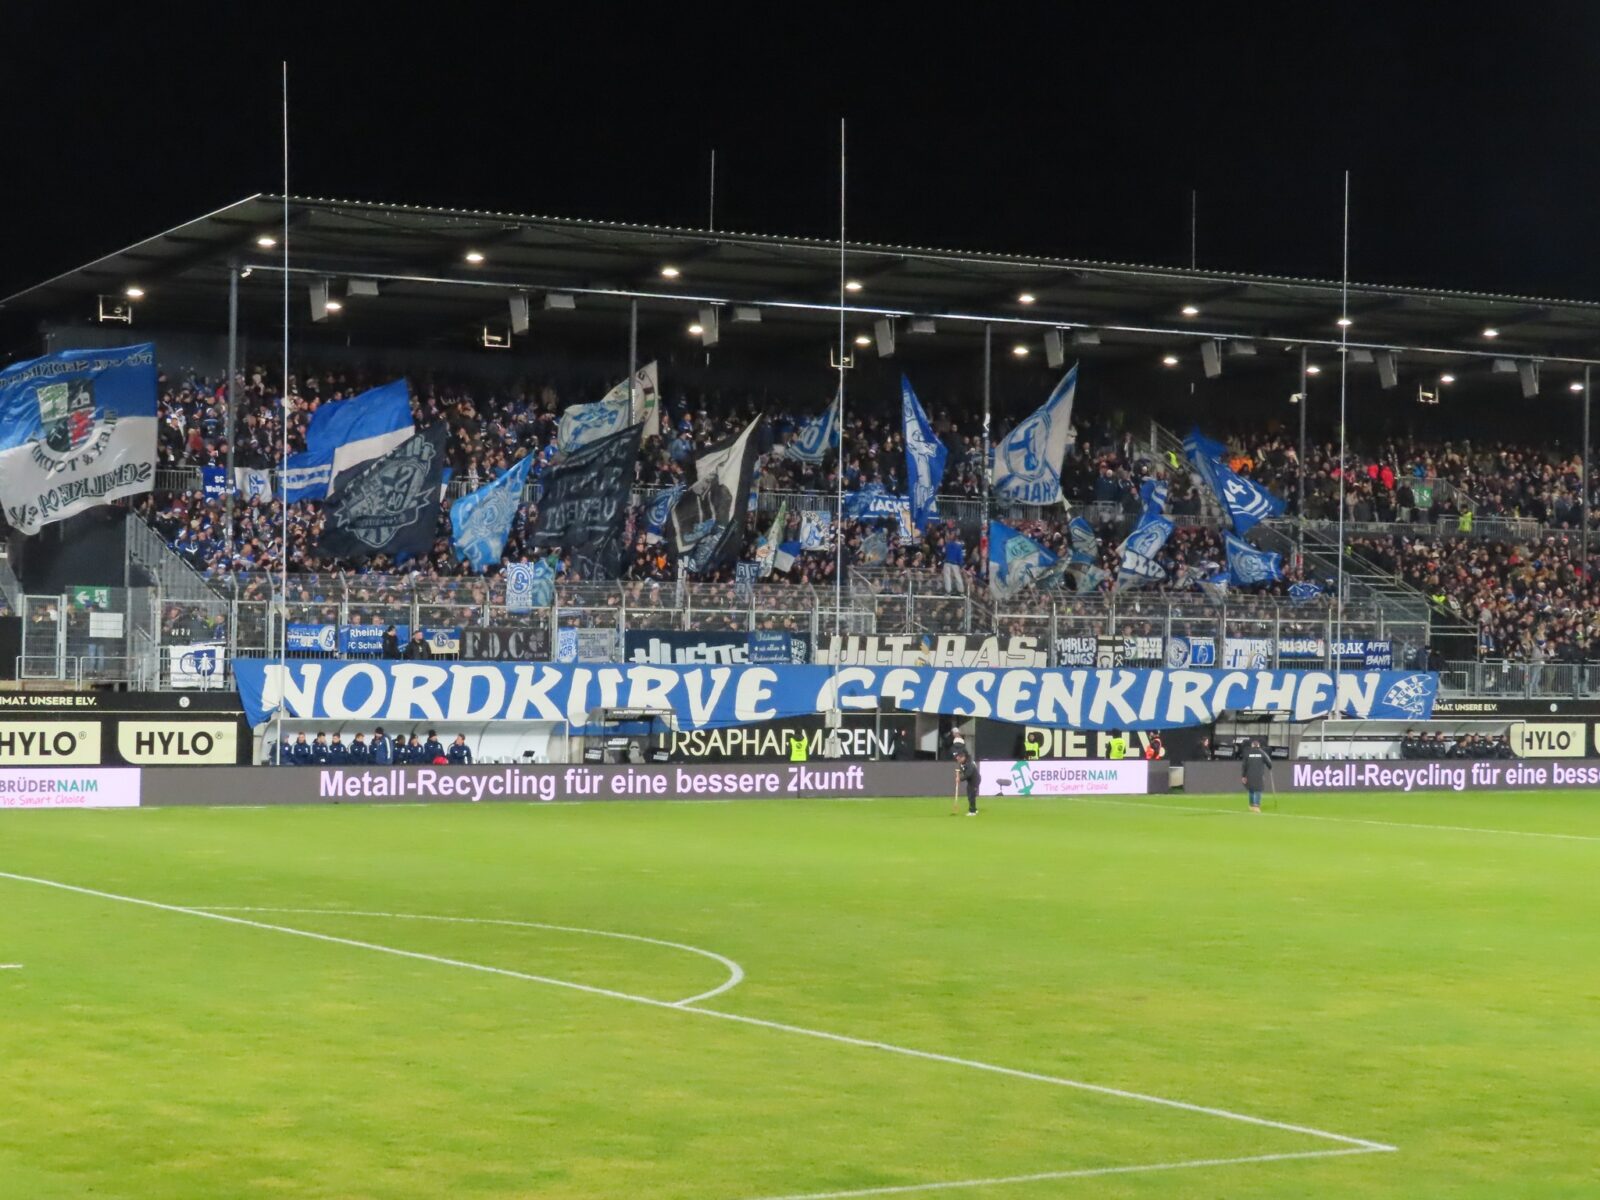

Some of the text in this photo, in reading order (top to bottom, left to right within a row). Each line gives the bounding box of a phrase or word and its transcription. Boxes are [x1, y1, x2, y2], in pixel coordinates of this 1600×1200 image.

[350, 627, 383, 639] Rheinla
[358, 641, 383, 650] Schalk
[29, 696, 73, 706] UNSERE
[75, 696, 97, 706] ELV.
[261, 663, 778, 731] NORDKURVE
[1455, 703, 1481, 712] UNSERE
[135, 731, 214, 756] HYLO
[1521, 731, 1571, 751] HYLO
[1032, 768, 1118, 781] GEBRÜDERNAIM
[1293, 762, 1600, 791] Metall-Recycling für eine bess
[320, 769, 556, 801] Metall-Recycling
[564, 769, 604, 794] für
[611, 770, 667, 794] eine
[676, 769, 780, 793] bessere
[19, 795, 51, 806] Smart
[55, 794, 86, 804] Choice
